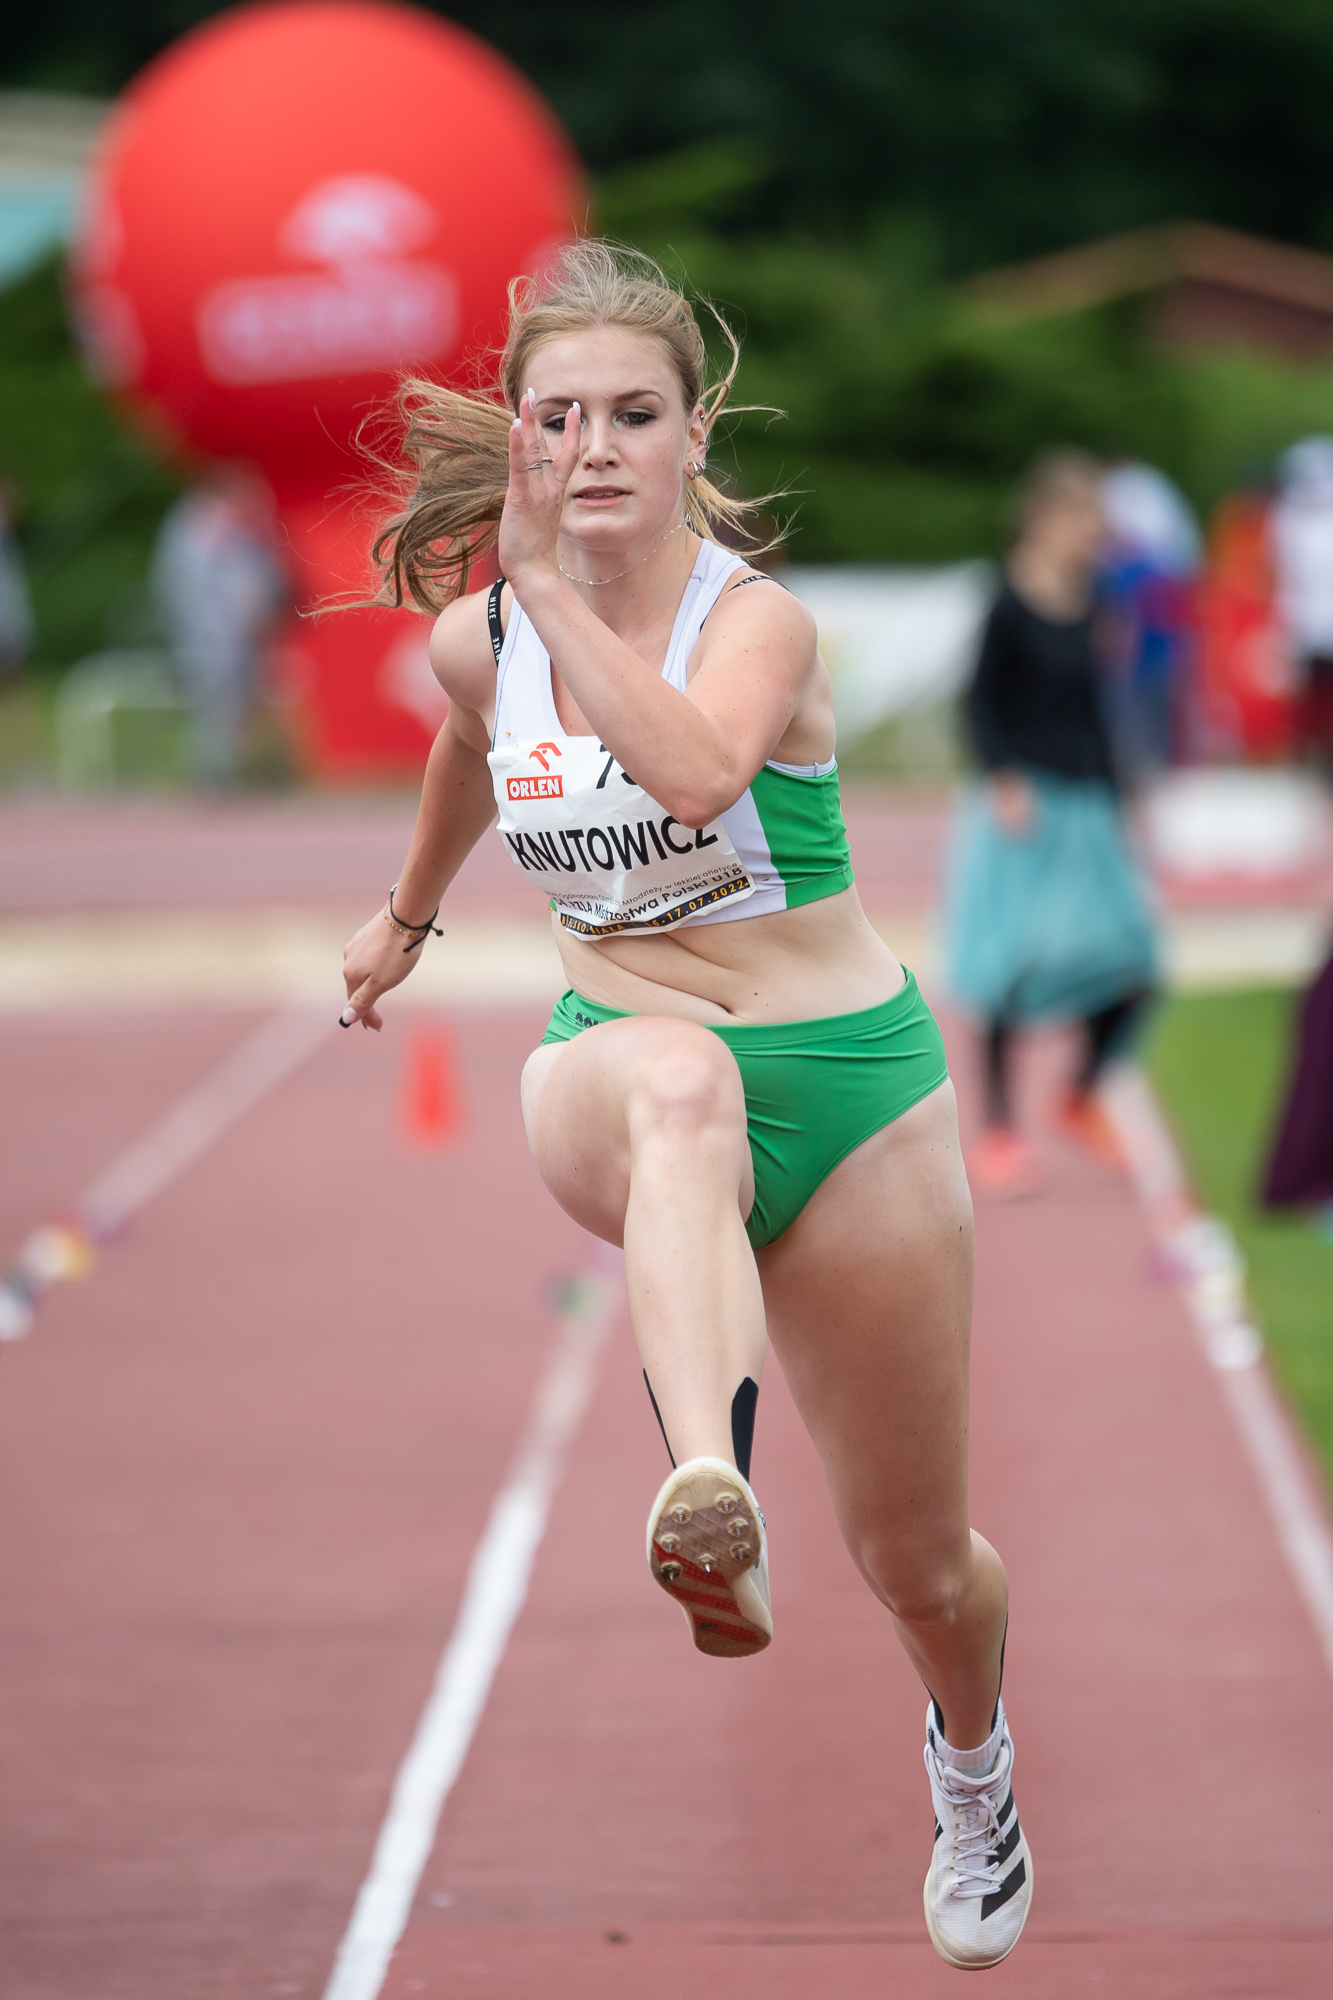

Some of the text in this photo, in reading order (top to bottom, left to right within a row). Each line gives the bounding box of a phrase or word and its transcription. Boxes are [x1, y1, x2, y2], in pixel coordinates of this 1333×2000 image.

[488, 596, 497, 620] NIKE
[509, 778, 560, 798] ORLEN
[505, 815, 719, 873] KNUTOWICZ
[622, 886, 663, 907] Młodzieży
[664, 882, 673, 890] w
[673, 874, 701, 888] lekkiej
[702, 862, 738, 878] atletyce
[661, 879, 709, 903] Polski
[712, 867, 743, 882] U18
